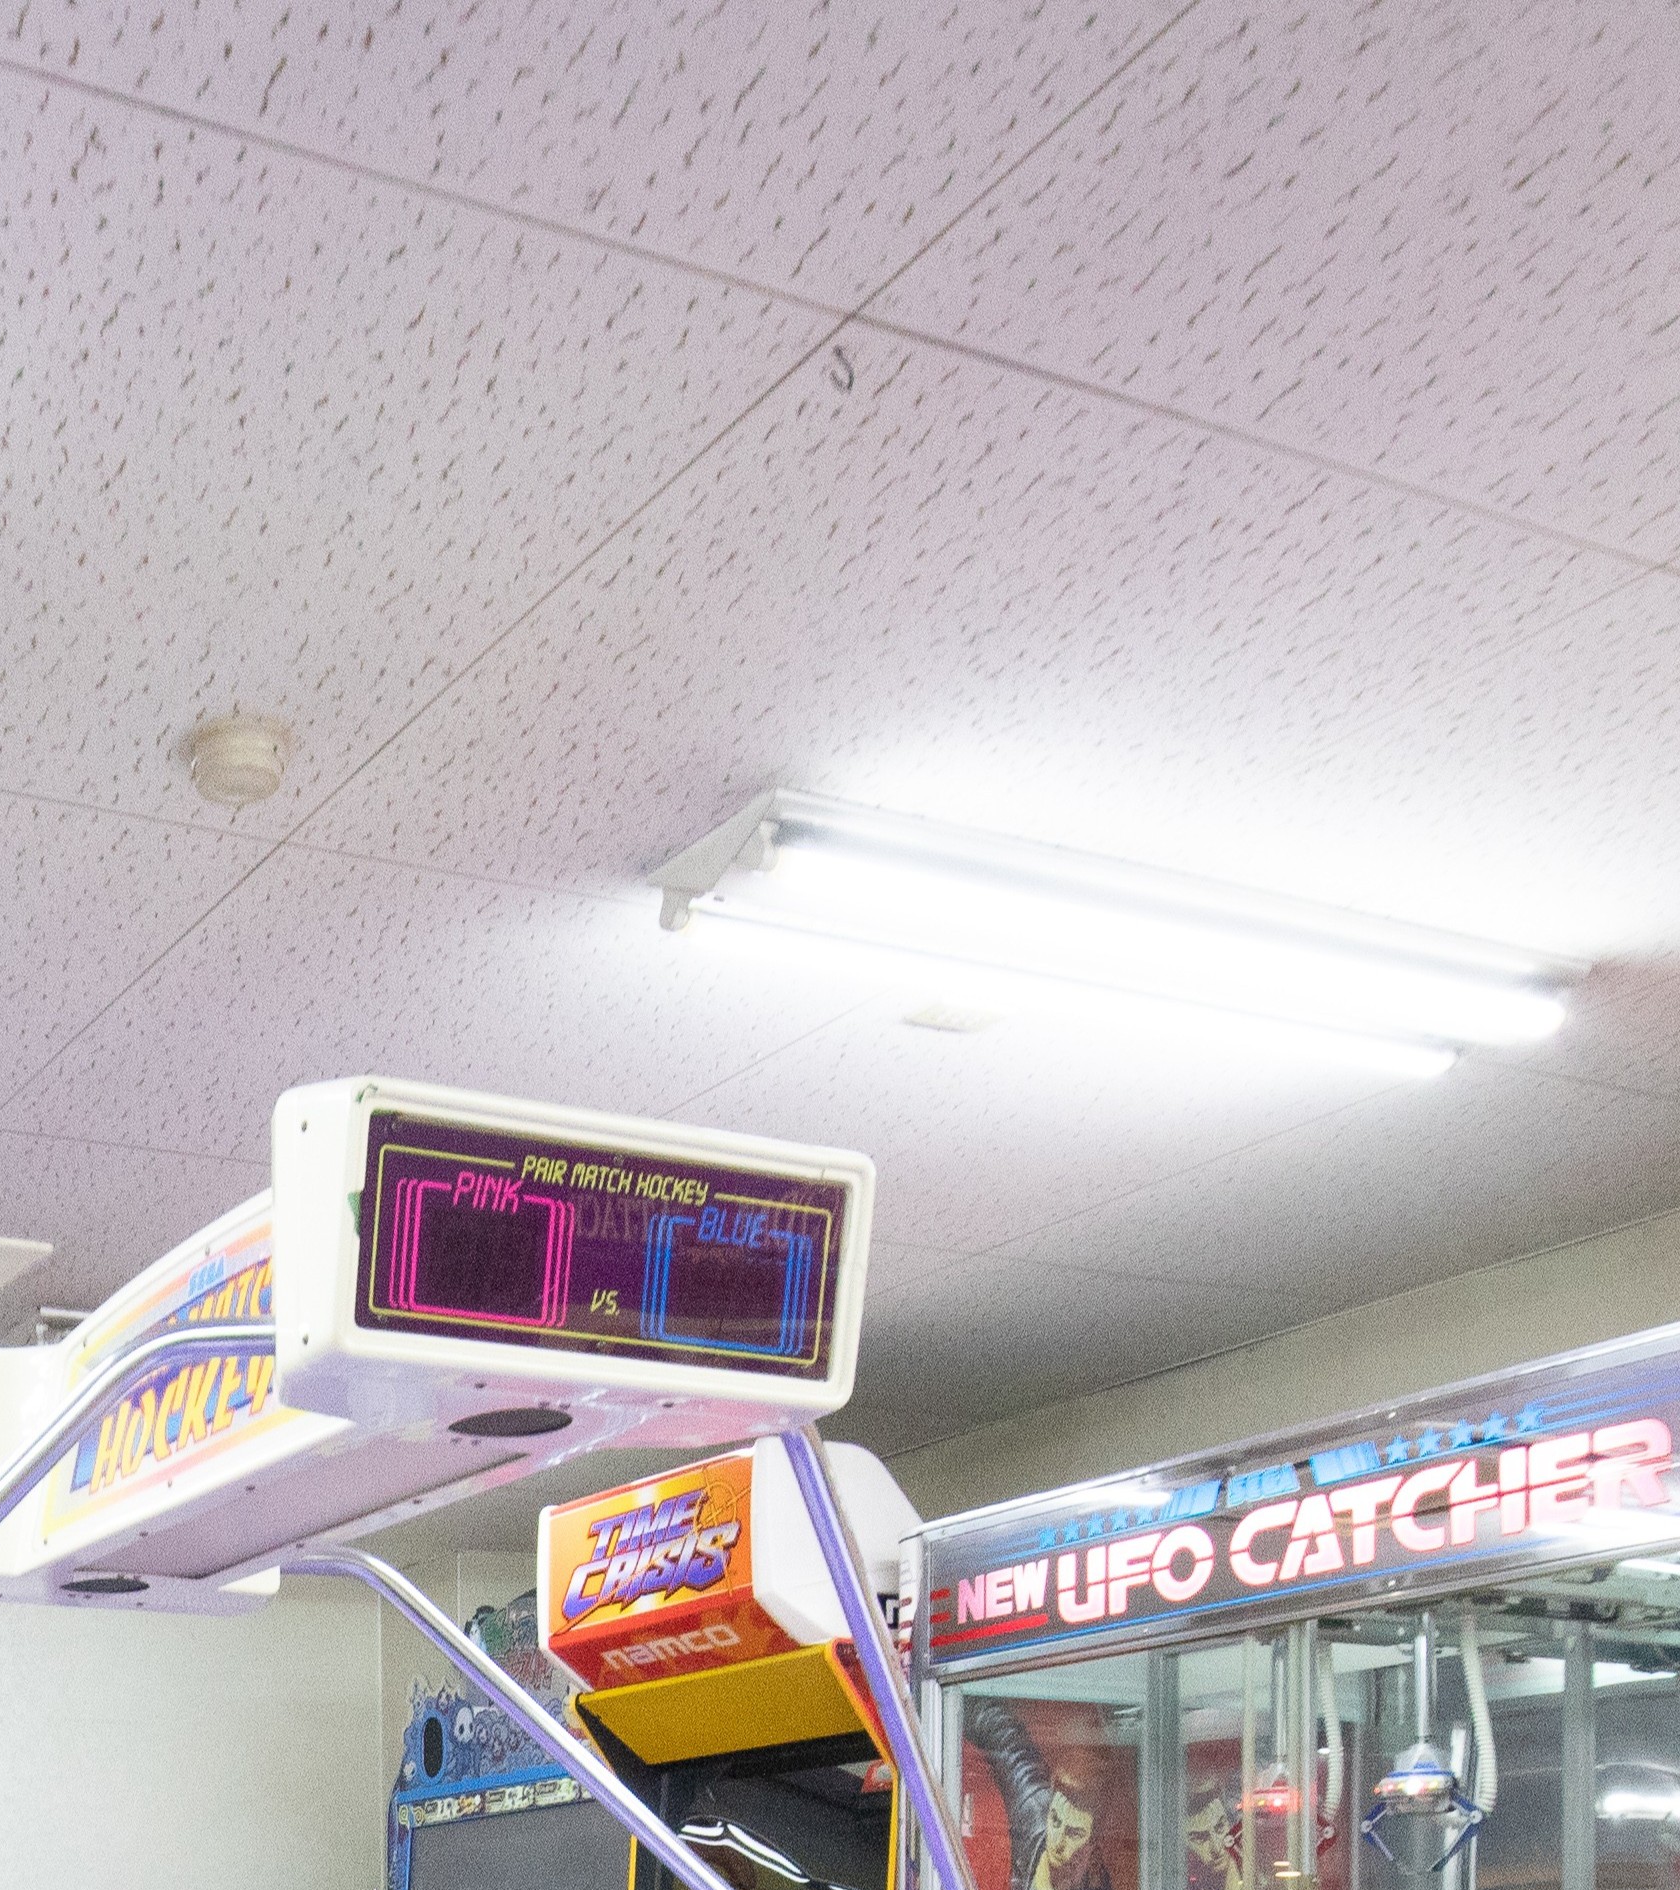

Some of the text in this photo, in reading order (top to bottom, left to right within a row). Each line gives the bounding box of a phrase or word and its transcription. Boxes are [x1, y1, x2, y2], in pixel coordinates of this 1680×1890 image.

[452, 1170, 522, 1214] PINK
[521, 1156, 709, 1205] PAIR MATCH HOCKEY
[697, 1206, 768, 1248] BLUE
[590, 1289, 622, 1316] VS.
[89, 1354, 275, 1494] HOCKEY
[956, 1417, 1674, 1626] NEW UFO CATCHER
[561, 1488, 742, 1624] TIME CRISIS
[600, 1623, 741, 1670] namco
